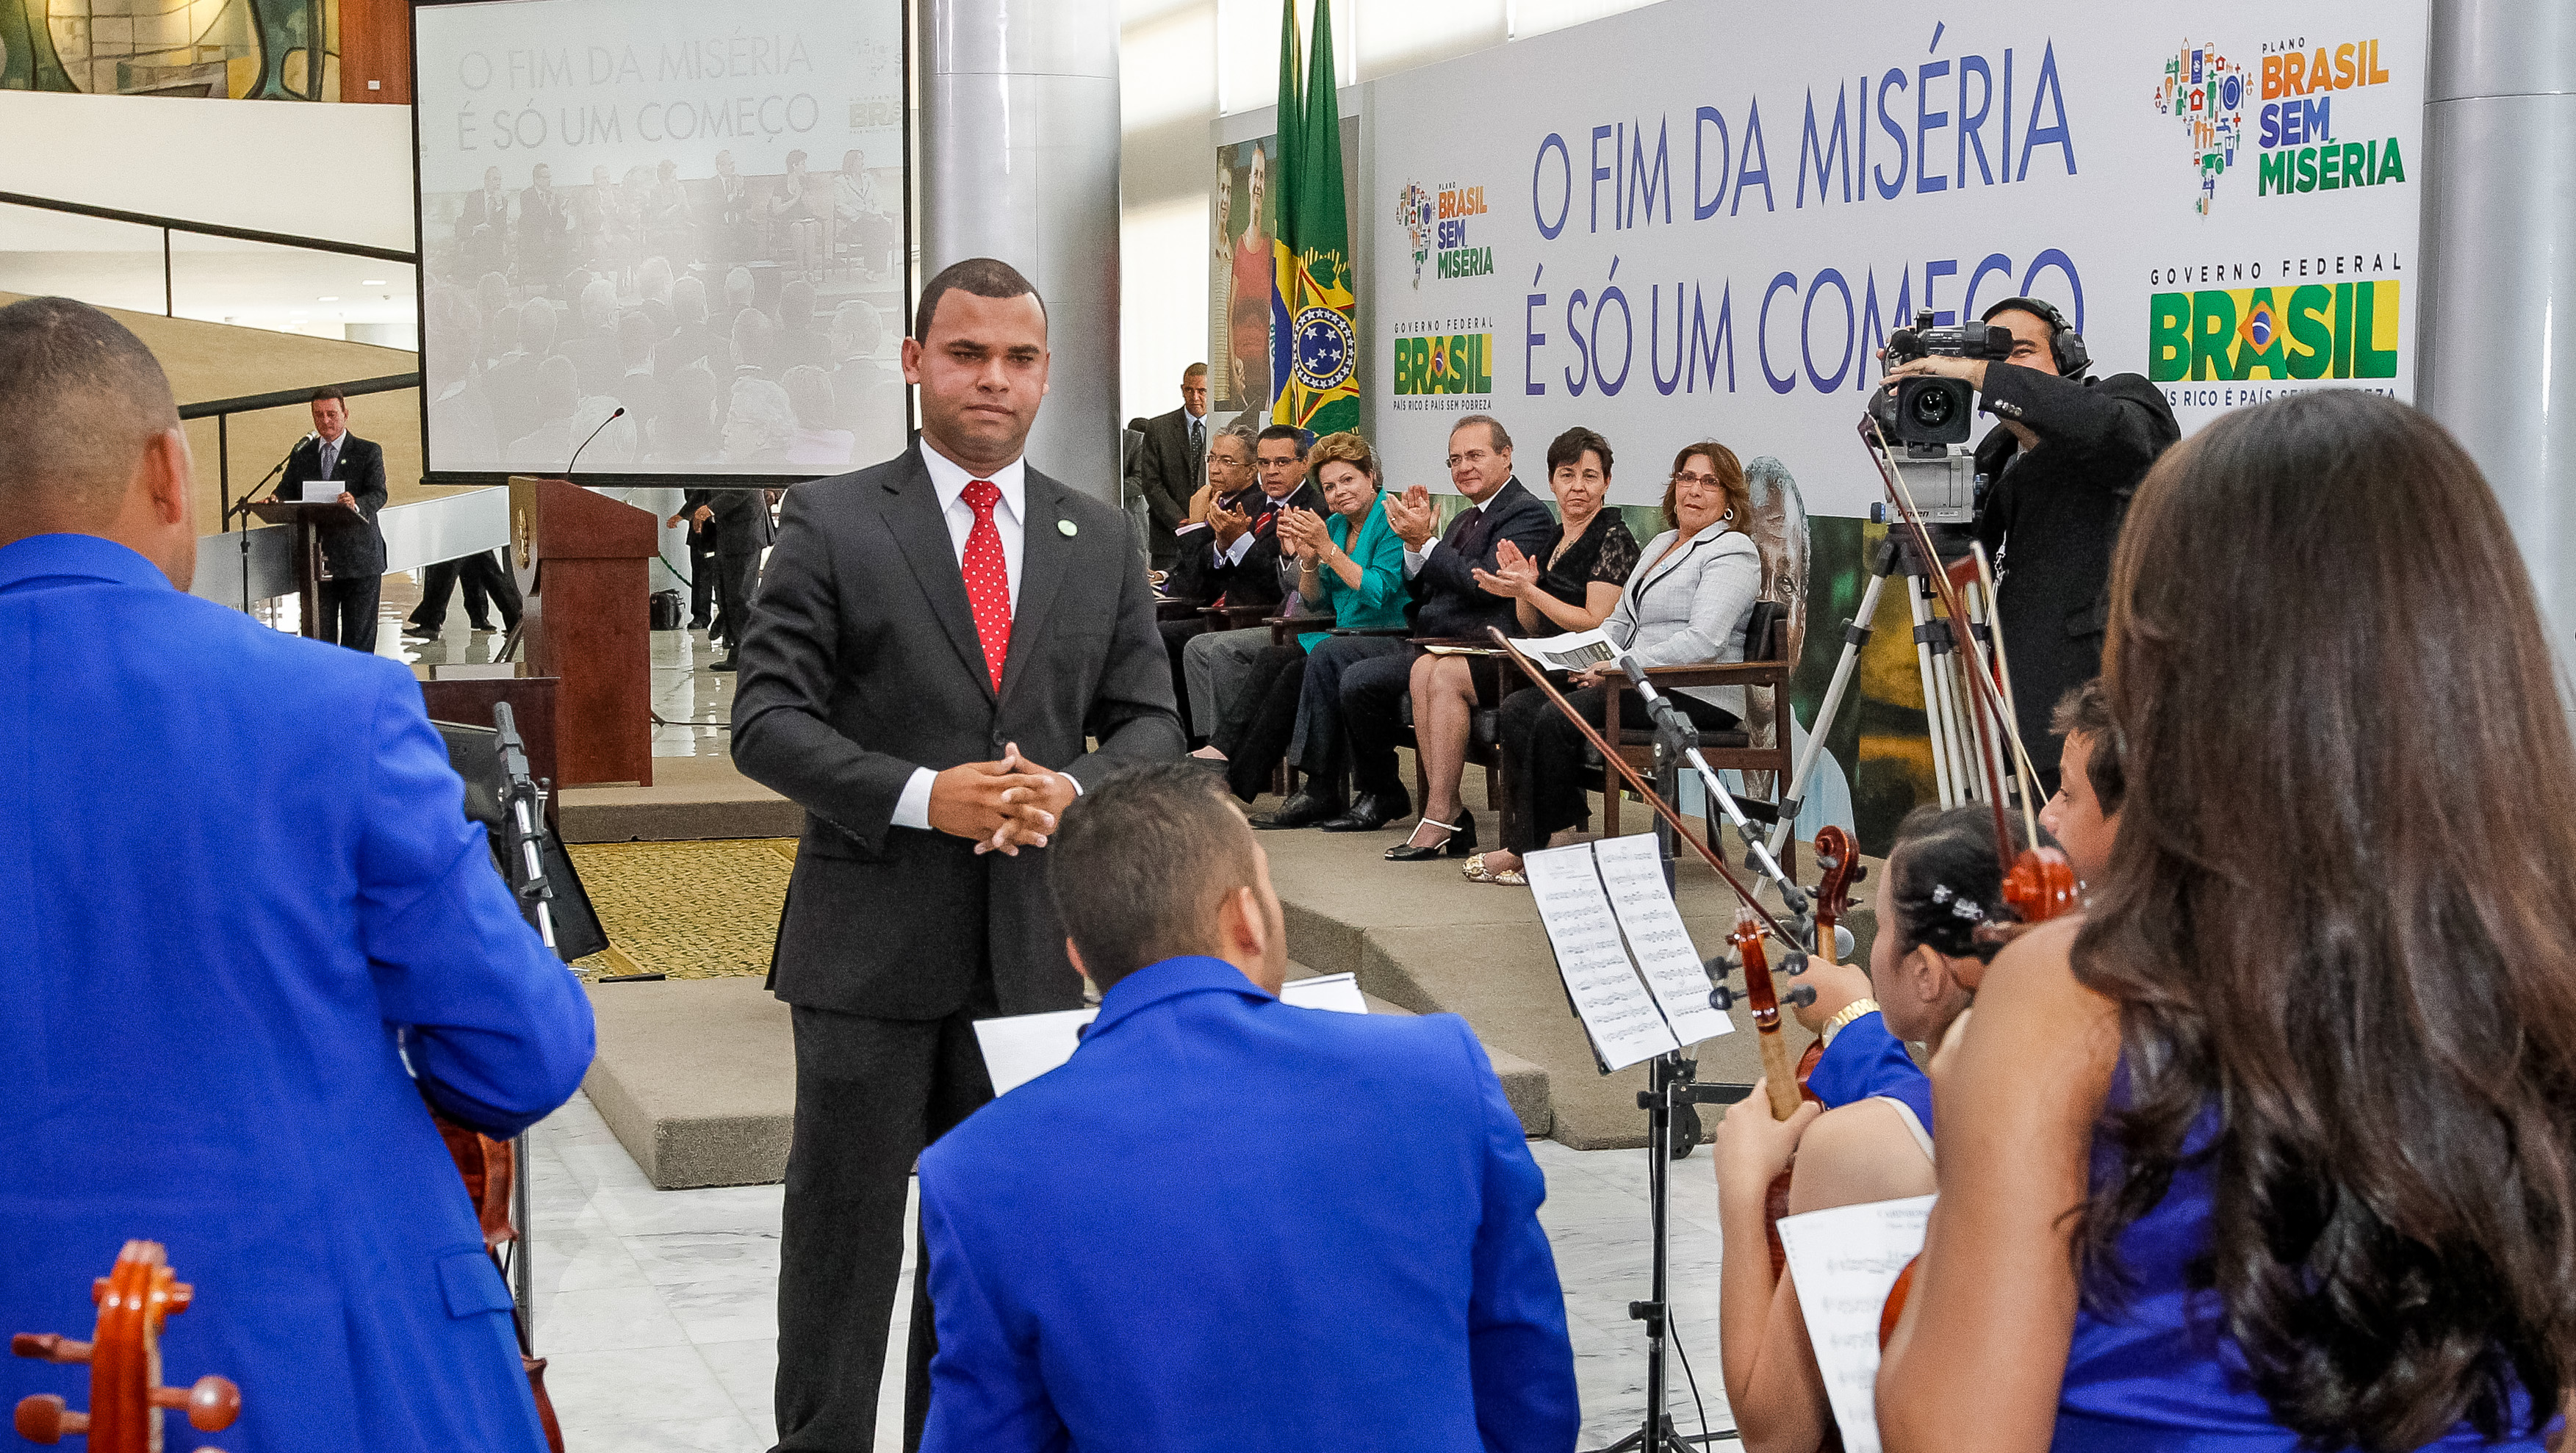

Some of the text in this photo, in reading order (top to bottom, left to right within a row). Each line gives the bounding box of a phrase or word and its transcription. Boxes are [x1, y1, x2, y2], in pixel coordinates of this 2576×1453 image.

[458, 26, 813, 91] O FIM DA MISÉRIA
[2261, 39, 2390, 101] BRASIL
[2262, 36, 2306, 53] PLANO
[457, 100, 478, 151] É
[492, 97, 547, 149] SÓ
[561, 104, 623, 147] UM
[636, 93, 819, 143] COMEÇO
[1532, 20, 2077, 240] O FIM DA MISÉRIA
[2258, 96, 2331, 149] SEM
[2258, 136, 2406, 197] MISÉRIA
[1438, 186, 1488, 220] BRASIL
[1437, 219, 1466, 250] SEM
[1437, 245, 1494, 279] MISÉRIA
[2150, 252, 2402, 286] GOVERNO FEDERAL
[1394, 317, 1493, 333] GOVERNO FEDERAL
[1525, 262, 1547, 397] É
[1564, 254, 1633, 397] SÓ
[1651, 275, 1736, 397] UM
[2148, 281, 2398, 383] BRASIL
[1394, 333, 1492, 395] BRASIL
[1393, 399, 1406, 411] PAÍS
[1408, 399, 1422, 411] RICO
[1431, 398, 1444, 411] PAÍS
[1446, 399, 1459, 411] SEM
[1461, 399, 1492, 411] POBREZA
[2184, 390, 2218, 406] RICO
[2226, 387, 2233, 406] É
